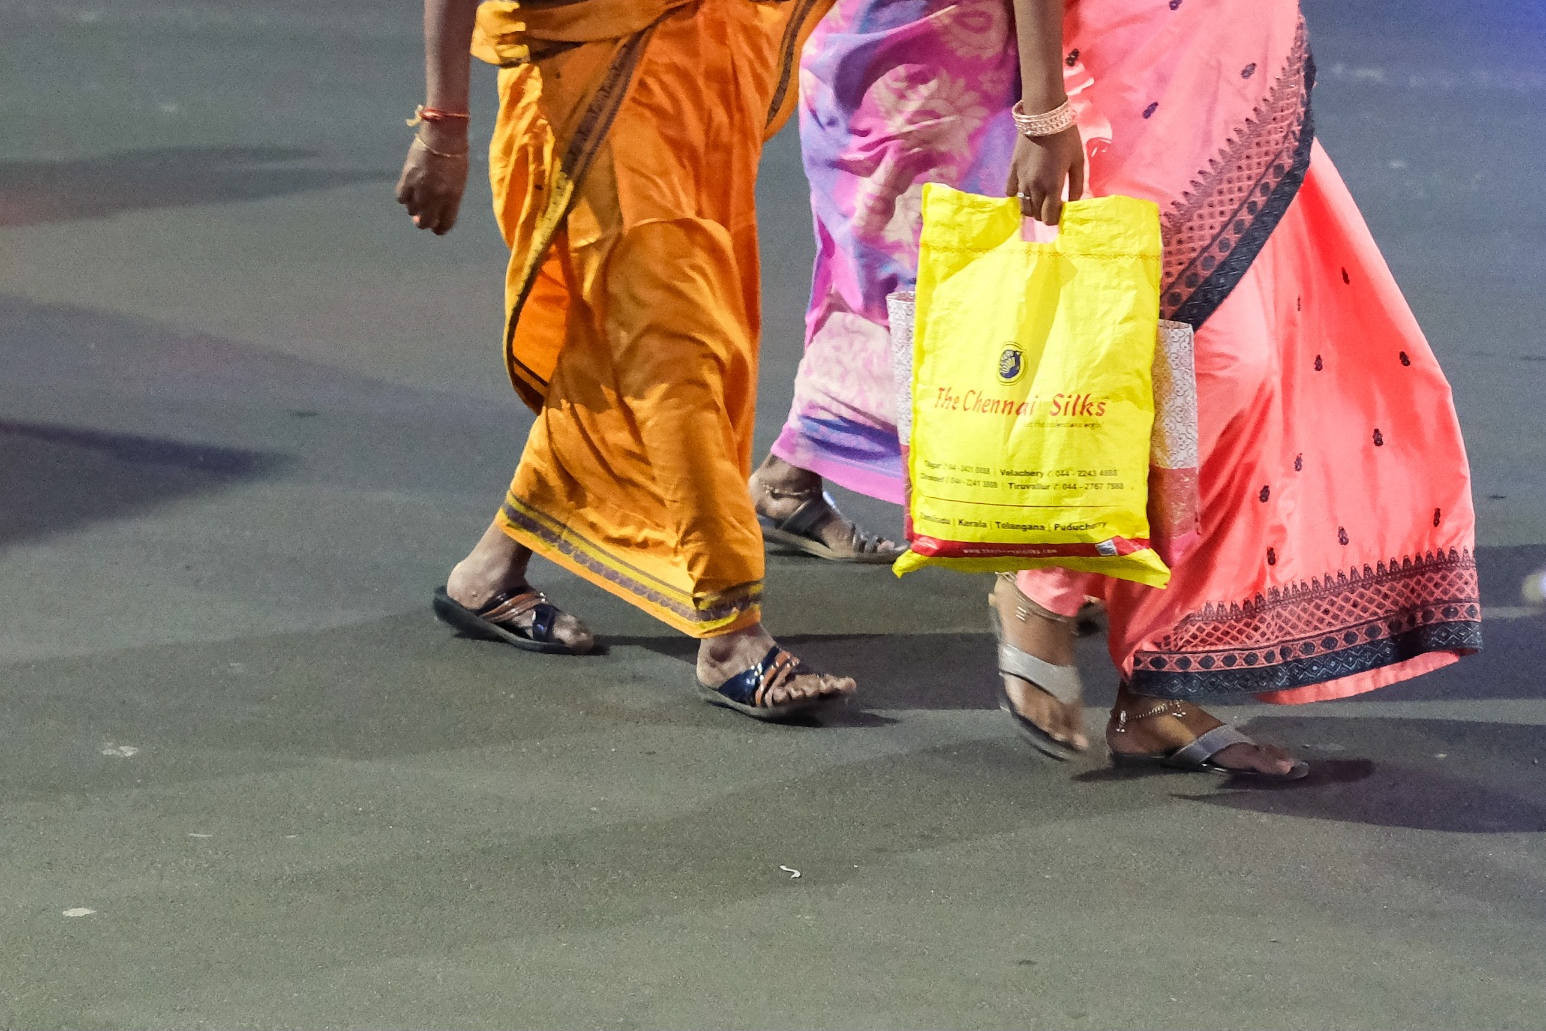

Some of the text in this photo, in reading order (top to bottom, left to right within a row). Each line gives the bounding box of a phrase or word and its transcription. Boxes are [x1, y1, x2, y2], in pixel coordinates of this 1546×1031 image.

[934, 386, 1107, 417] The Chennai Silks
[958, 519, 1107, 531] Kerala Telangana Puducherry
